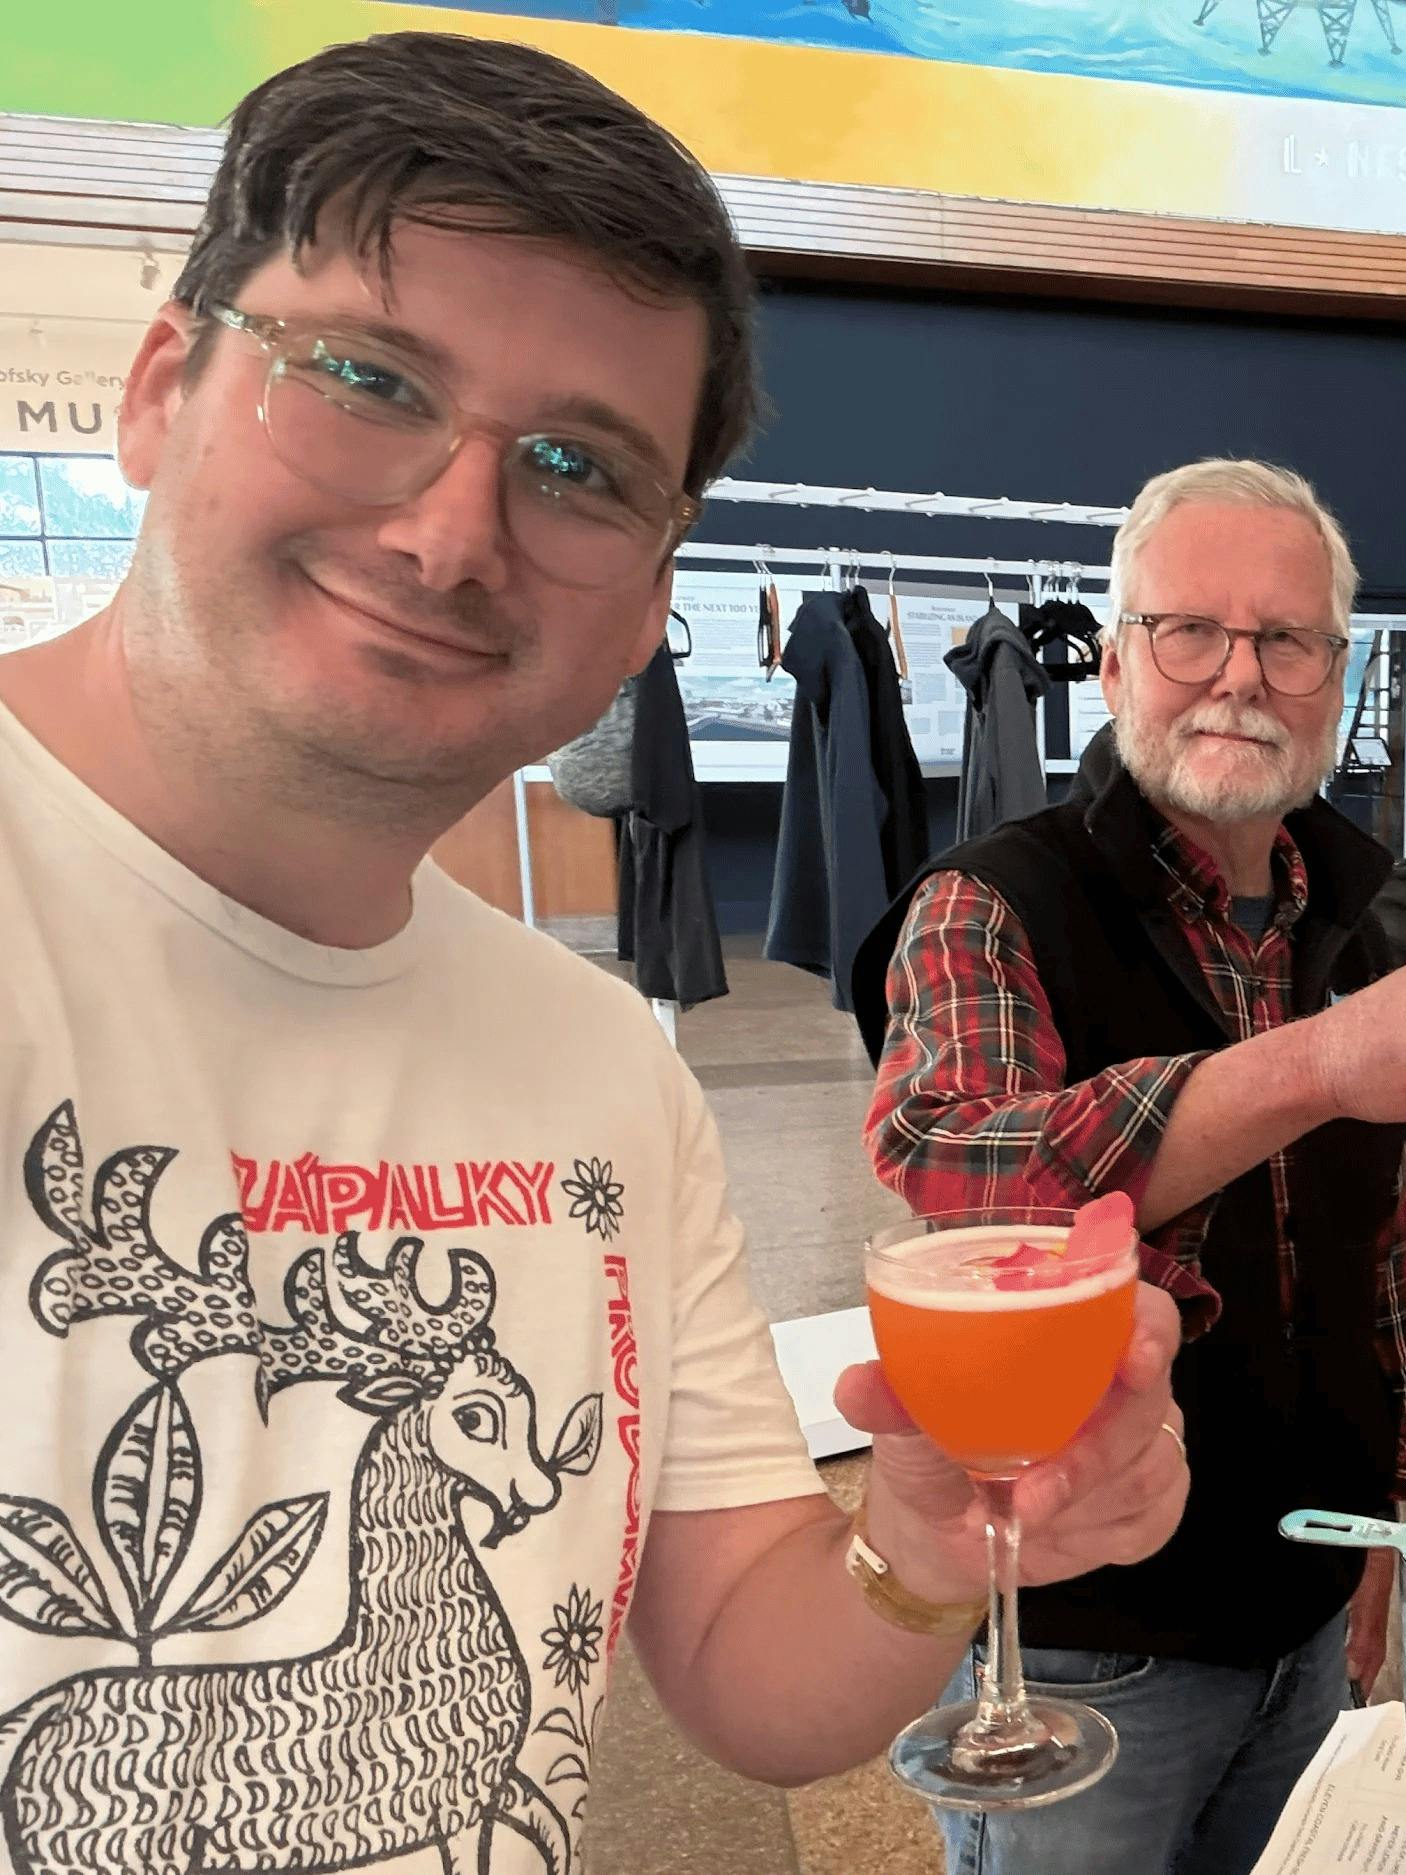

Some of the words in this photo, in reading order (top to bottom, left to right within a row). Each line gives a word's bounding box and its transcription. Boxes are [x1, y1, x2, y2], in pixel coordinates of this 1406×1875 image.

[16, 400, 121, 435] MU
[683, 602, 701, 613] THE
[703, 603, 728, 614] NEXT
[729, 604, 748, 614] 100
